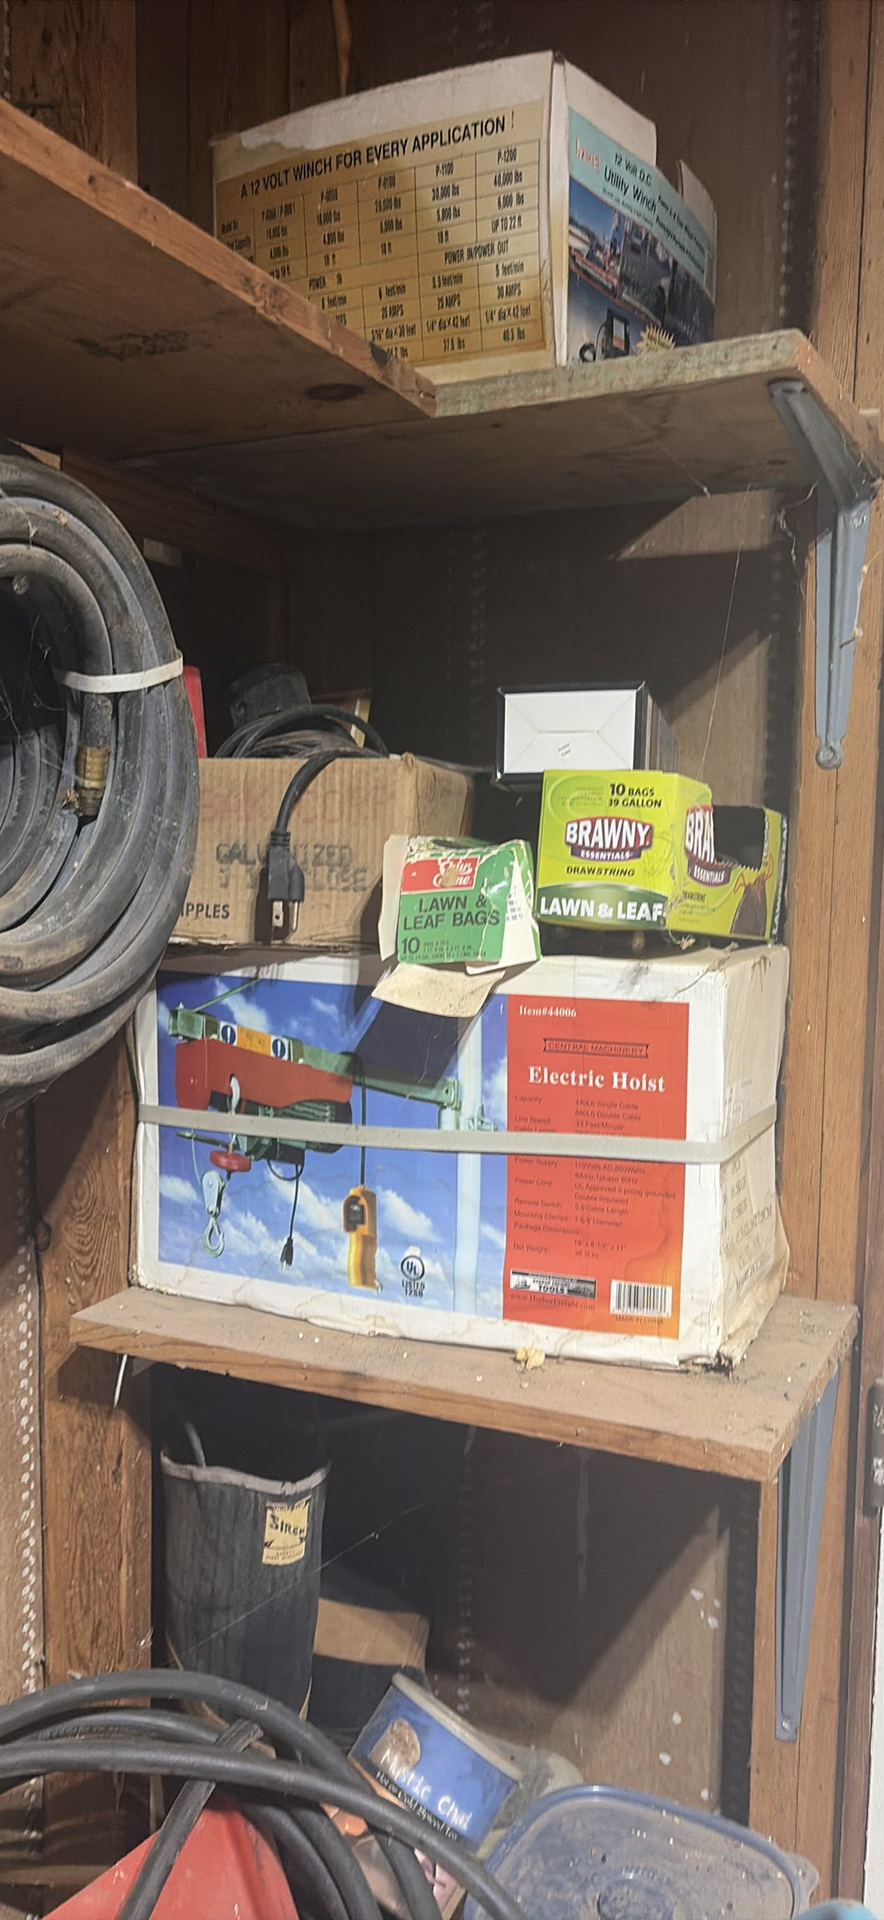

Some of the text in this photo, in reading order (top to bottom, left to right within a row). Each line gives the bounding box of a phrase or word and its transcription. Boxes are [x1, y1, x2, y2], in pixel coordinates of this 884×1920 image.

[241, 183, 248, 199] A
[251, 181, 260, 196] 12
[263, 169, 290, 191] VOLT
[293, 157, 332, 182] WINCH
[336, 150, 362, 170] FOR
[366, 138, 408, 164] EVERY
[412, 116, 505, 153] APPLICATION
[497, 148, 518, 165] P-1200
[613, 152, 622, 167] 12
[624, 159, 638, 176] Volt
[435, 161, 454, 178] P-1100
[604, 165, 630, 196] Utility
[633, 185, 657, 215] Winch
[491, 220, 500, 234] UP
[500, 218, 508, 232] TO
[444, 249, 464, 265] POWER
[497, 239, 509, 255] OUT
[504, 282, 522, 298] AMPS
[609, 783, 626, 796] 10
[628, 787, 655, 797] BAGS
[608, 799, 619, 808] 39
[622, 799, 662, 808] GALLON
[685, 810, 715, 863] BRA
[581, 849, 632, 861] ESSENTIALS
[566, 866, 635, 877] DRAWSTRING
[693, 865, 725, 883] ESSENTIALS
[419, 894, 487, 912] LAWN &
[540, 897, 594, 918] LAWN
[597, 903, 614, 918] &
[617, 901, 663, 922] LEAF
[403, 911, 500, 931] LEAF BAGS
[402, 937, 420, 955] 10
[519, 1005, 577, 1018] Item#44006
[548, 1042, 644, 1055] CENTRAL MACHINERY
[528, 1066, 666, 1092] Electric Hoist
[644, 1189, 676, 1199] grounded
[539, 1286, 564, 1294] TOOLS
[380, 1748, 432, 1800] Mystic
